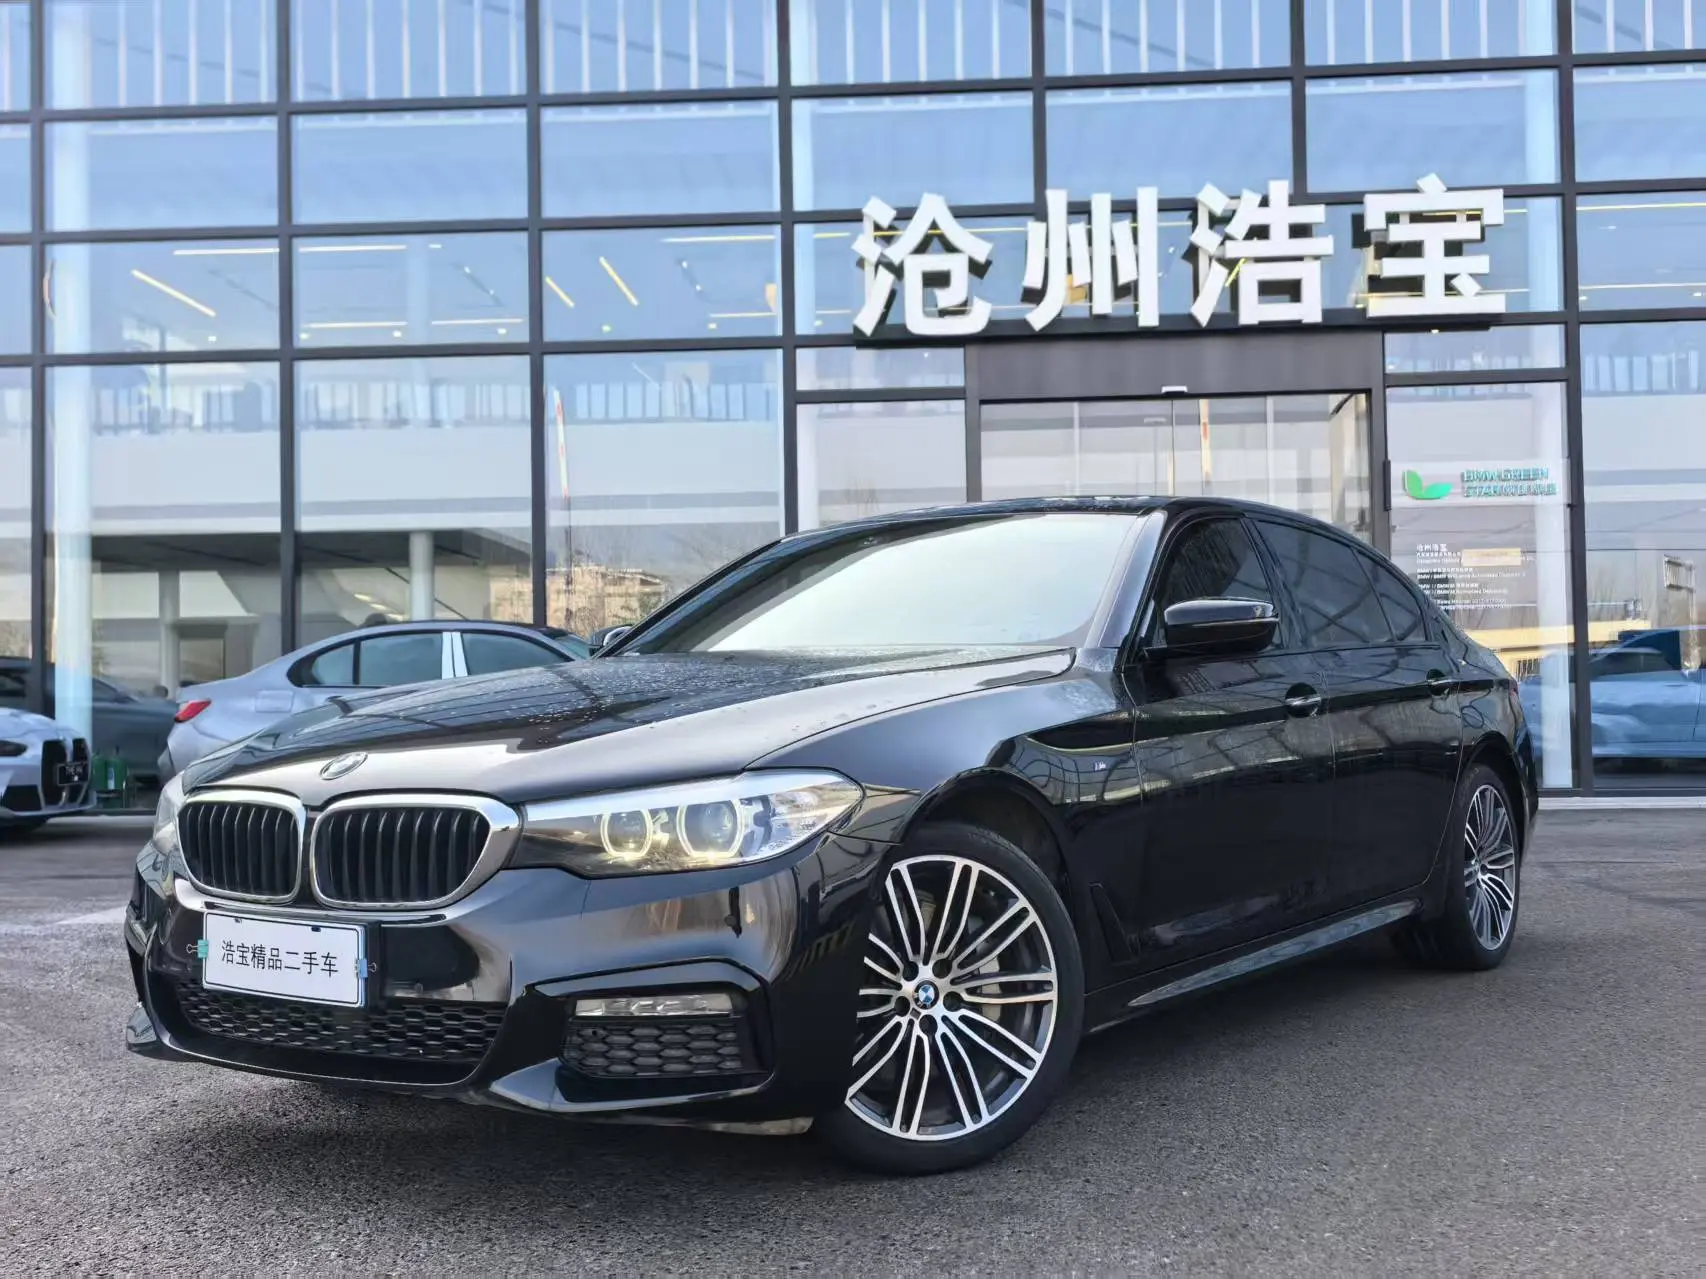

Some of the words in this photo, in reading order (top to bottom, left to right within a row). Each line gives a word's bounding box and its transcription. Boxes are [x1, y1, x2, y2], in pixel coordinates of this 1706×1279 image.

[852, 173, 1506, 336] 沧州浩宝
[222, 940, 338, 978] 浩宝精品二手车
